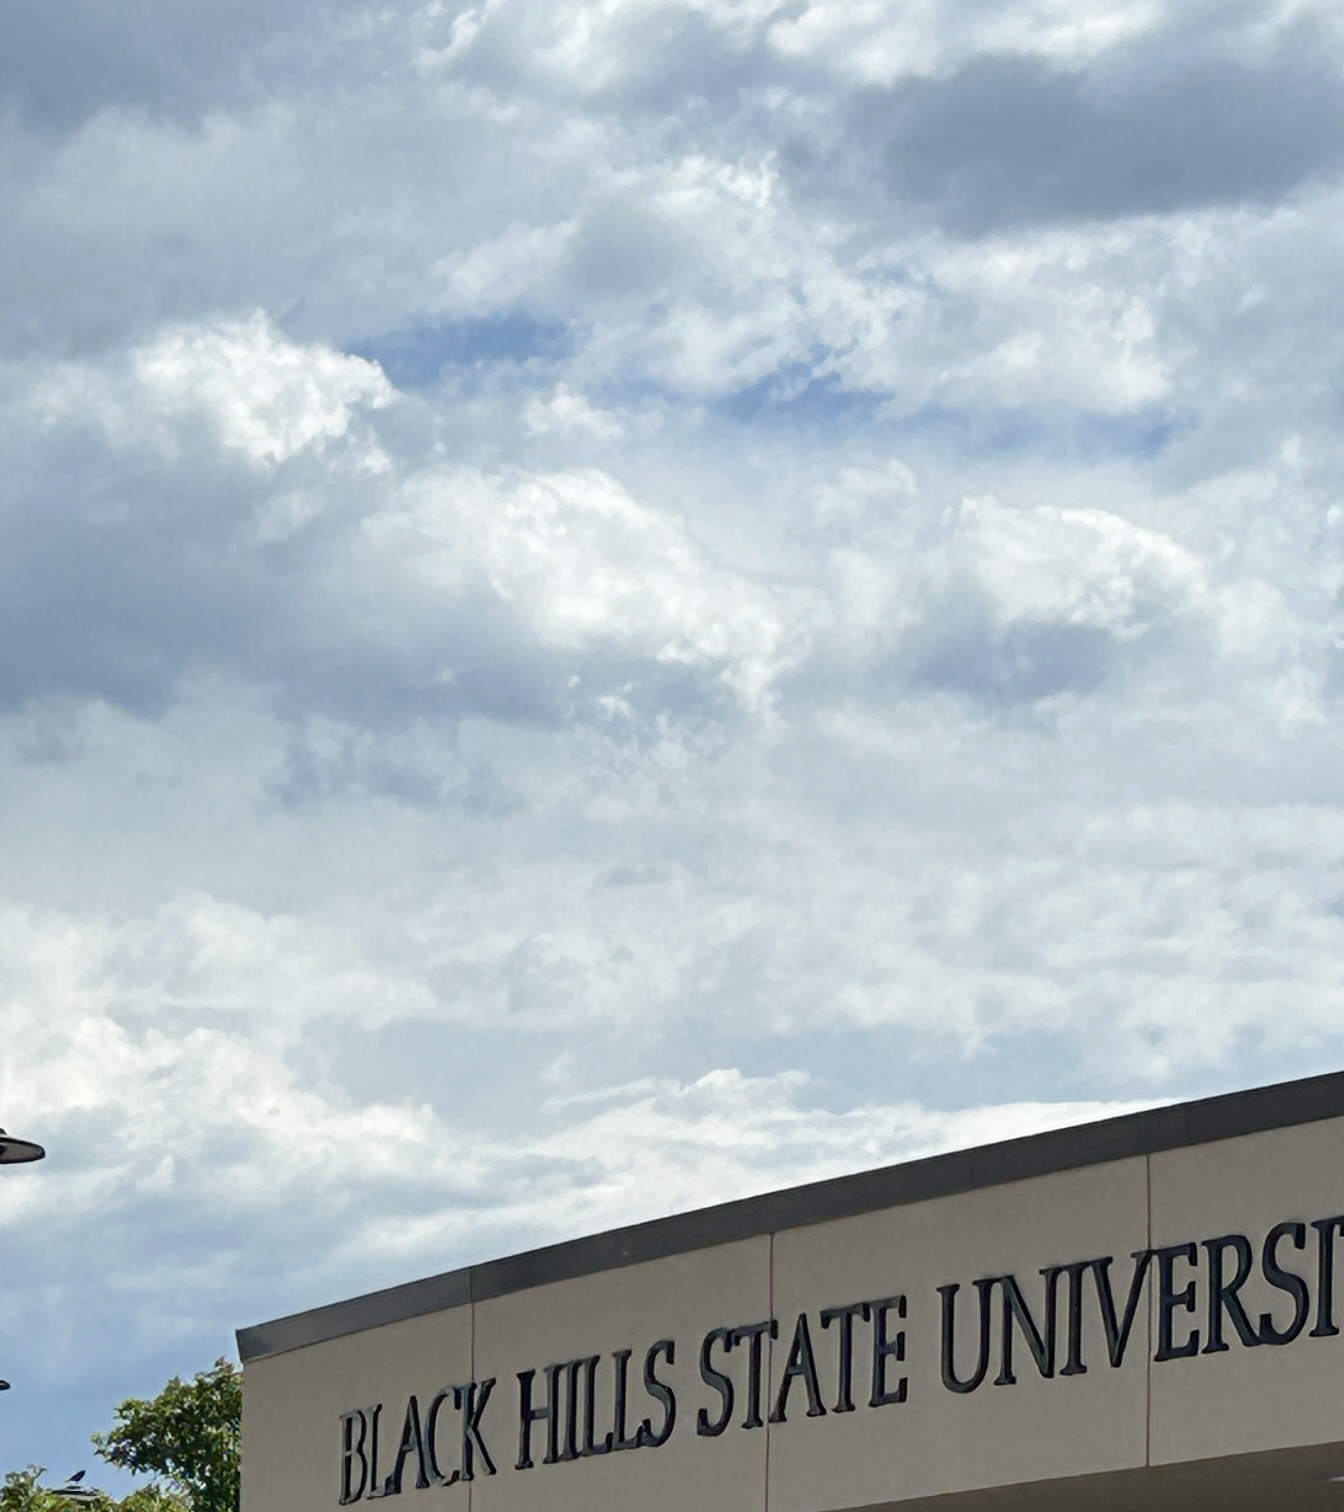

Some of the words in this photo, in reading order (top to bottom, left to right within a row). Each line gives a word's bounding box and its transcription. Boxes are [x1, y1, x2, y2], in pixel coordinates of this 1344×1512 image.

[338, 1376, 497, 1506] BLACK
[514, 1340, 676, 1470] HILLS
[696, 1294, 908, 1437] STATE
